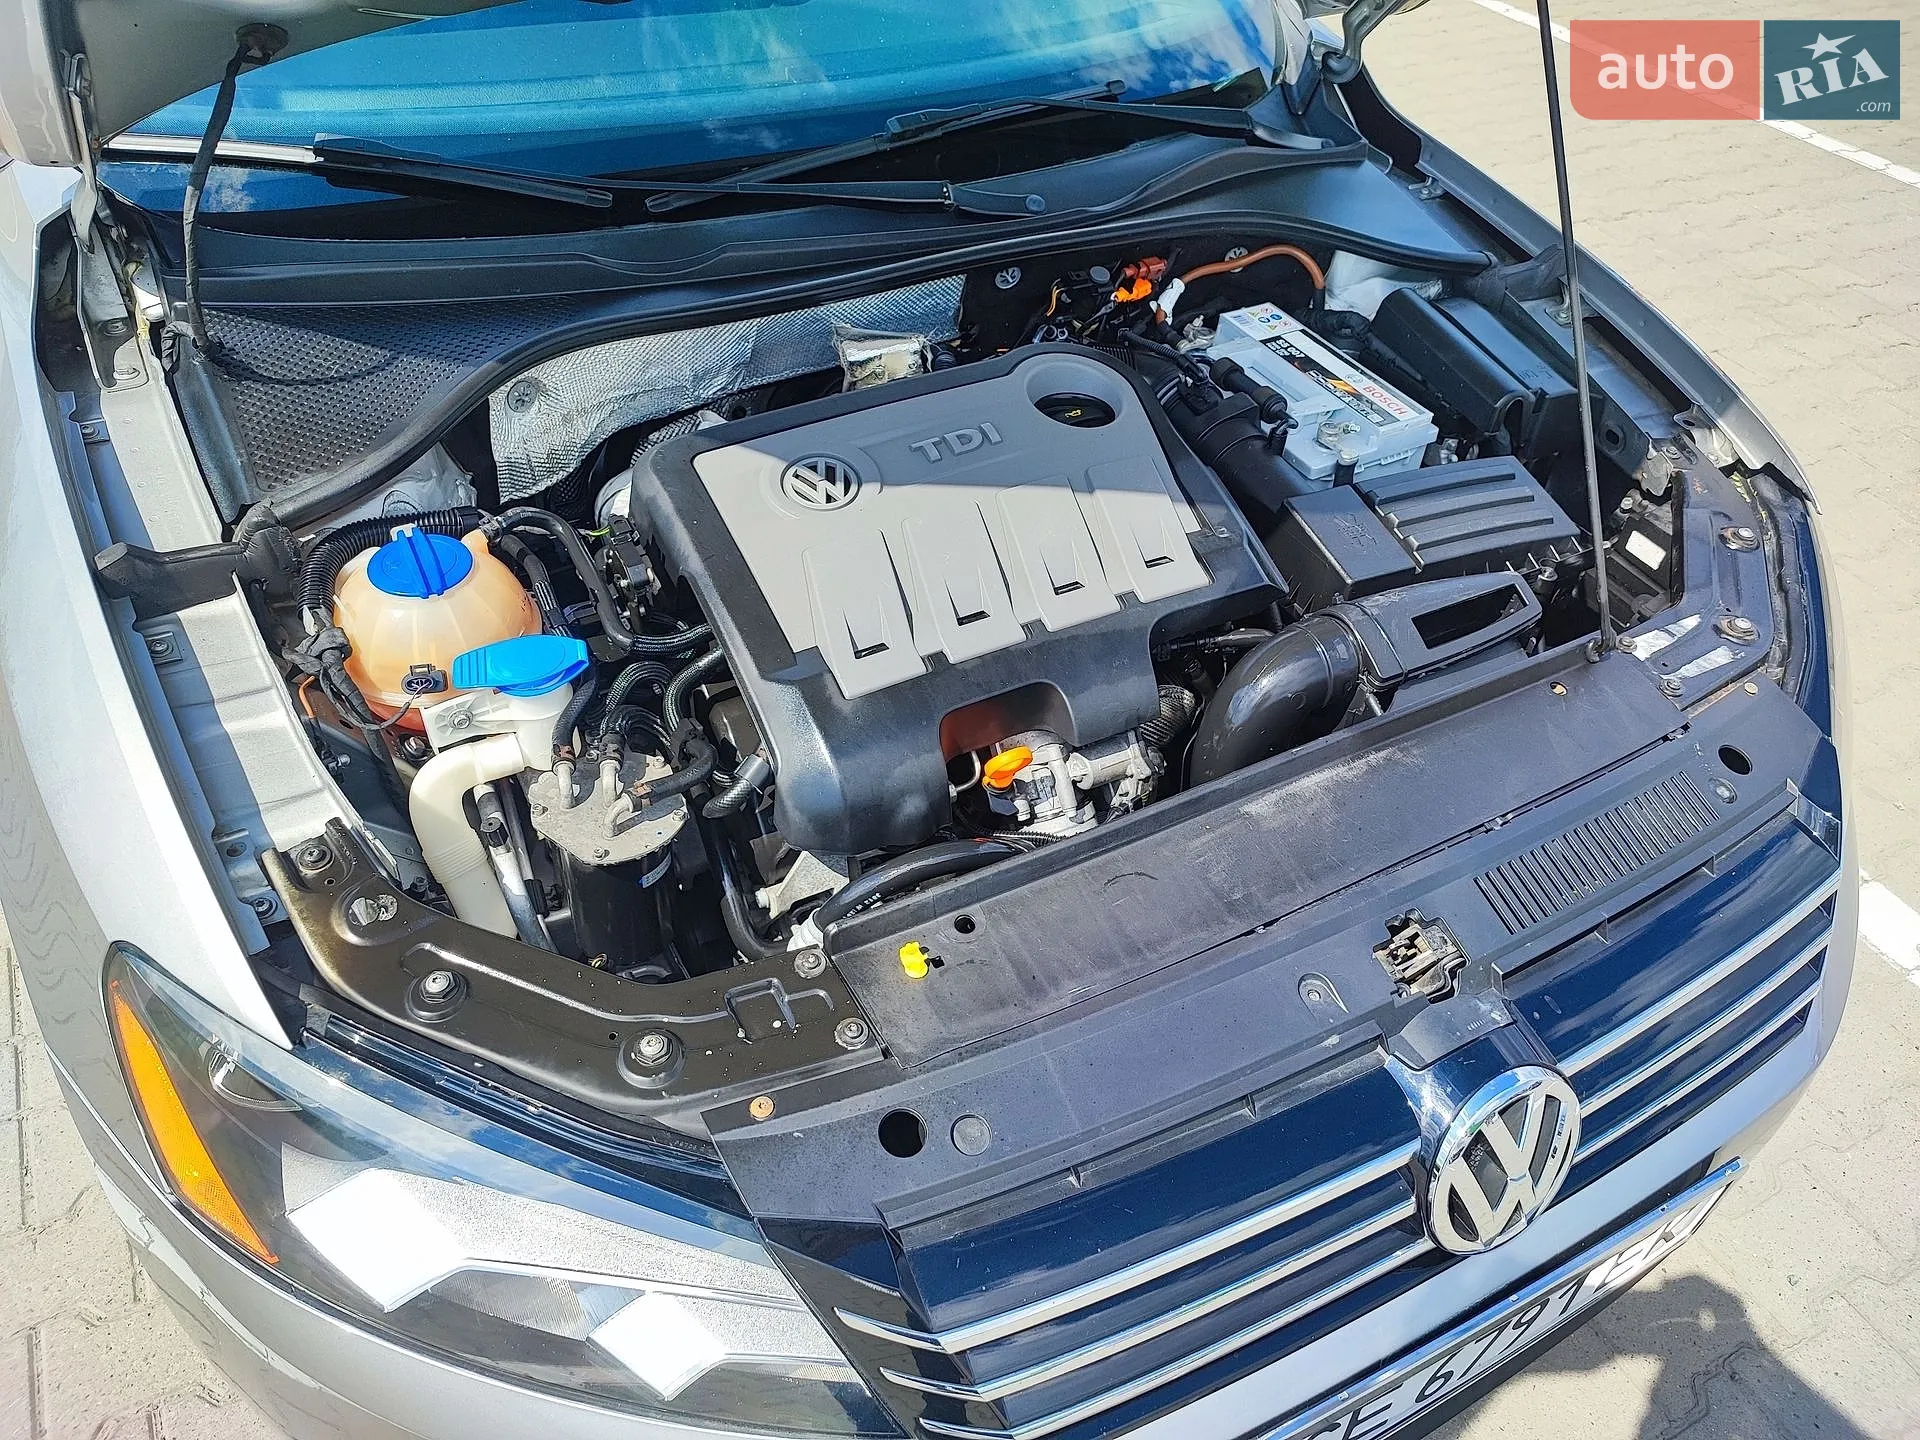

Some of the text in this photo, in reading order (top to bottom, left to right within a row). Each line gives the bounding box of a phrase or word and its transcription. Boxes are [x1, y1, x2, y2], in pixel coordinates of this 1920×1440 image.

[1363, 385, 1408, 415] BOSCH
[910, 422, 1003, 463] TDI
[1415, 1270, 1591, 1403] 6791
